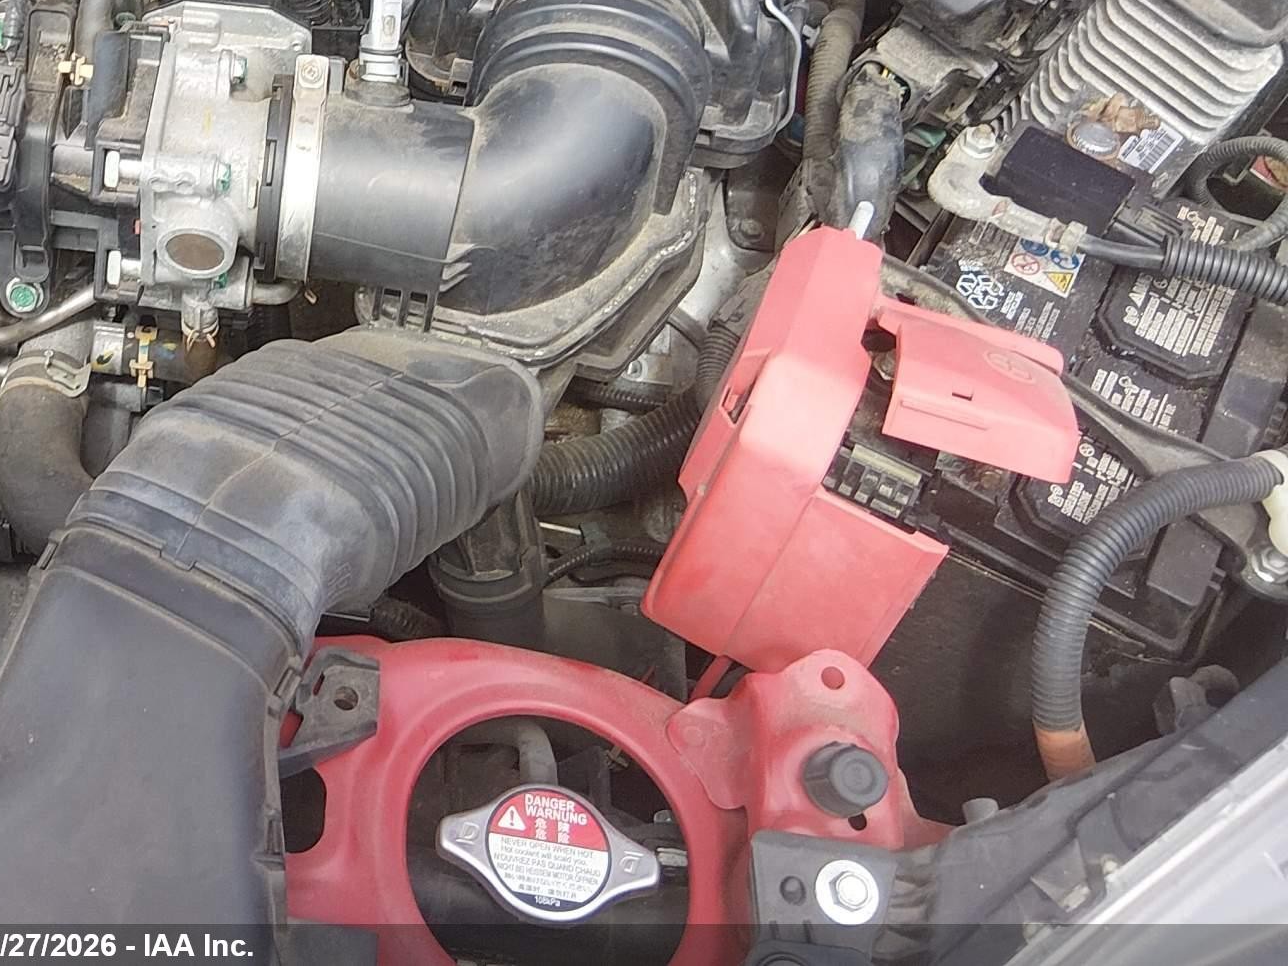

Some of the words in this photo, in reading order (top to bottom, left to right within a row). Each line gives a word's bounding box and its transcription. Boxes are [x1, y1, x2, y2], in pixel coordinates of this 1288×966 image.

[525, 794, 575, 812] DANGER
[525, 805, 587, 825] WARNUNG
[529, 841, 550, 851] OPEN
[578, 850, 593, 859] HOT
